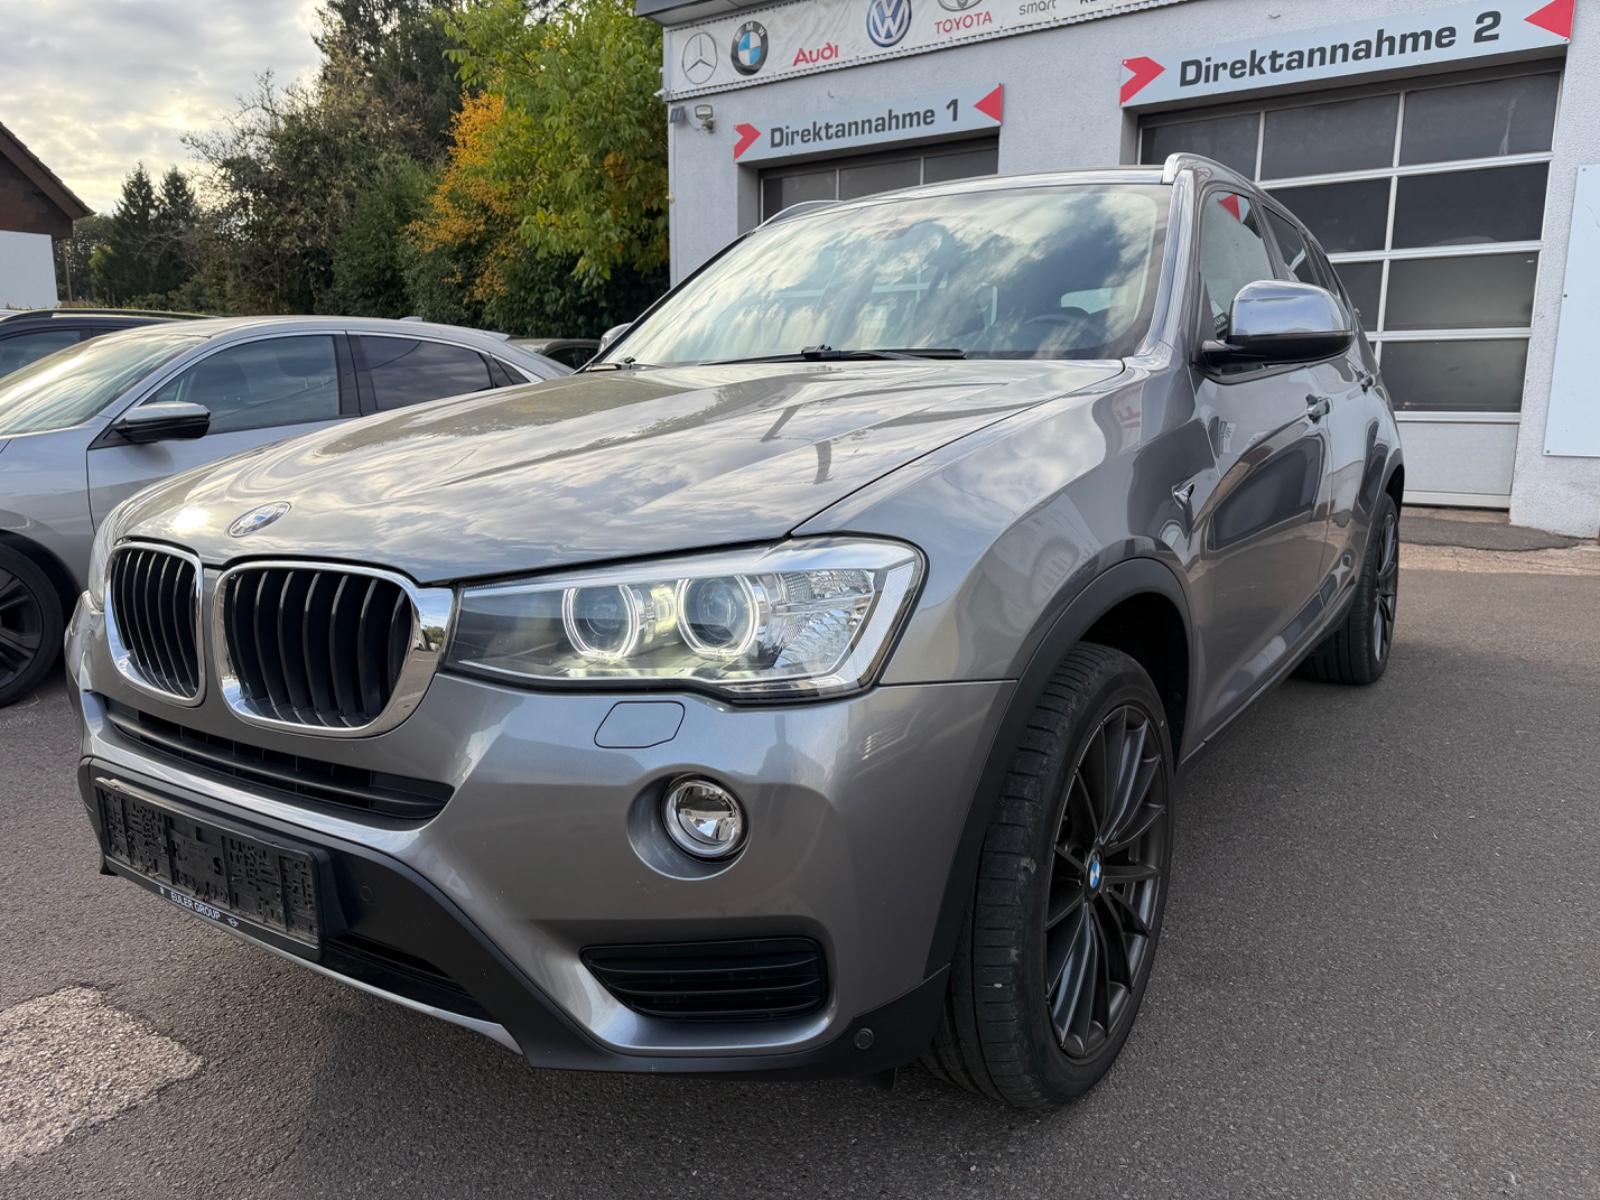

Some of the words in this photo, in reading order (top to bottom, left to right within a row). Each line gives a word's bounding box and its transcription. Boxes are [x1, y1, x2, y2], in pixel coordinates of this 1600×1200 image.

[1019, 0, 1056, 15] smart
[934, 11, 993, 34] TOYOTA
[792, 42, 839, 67] Audi
[1180, 26, 1457, 87] Direktannahme
[1473, 10, 1502, 43] 2
[769, 104, 936, 148] Direktannahme
[945, 98, 959, 122] 1
[194, 902, 220, 920] GROUP
